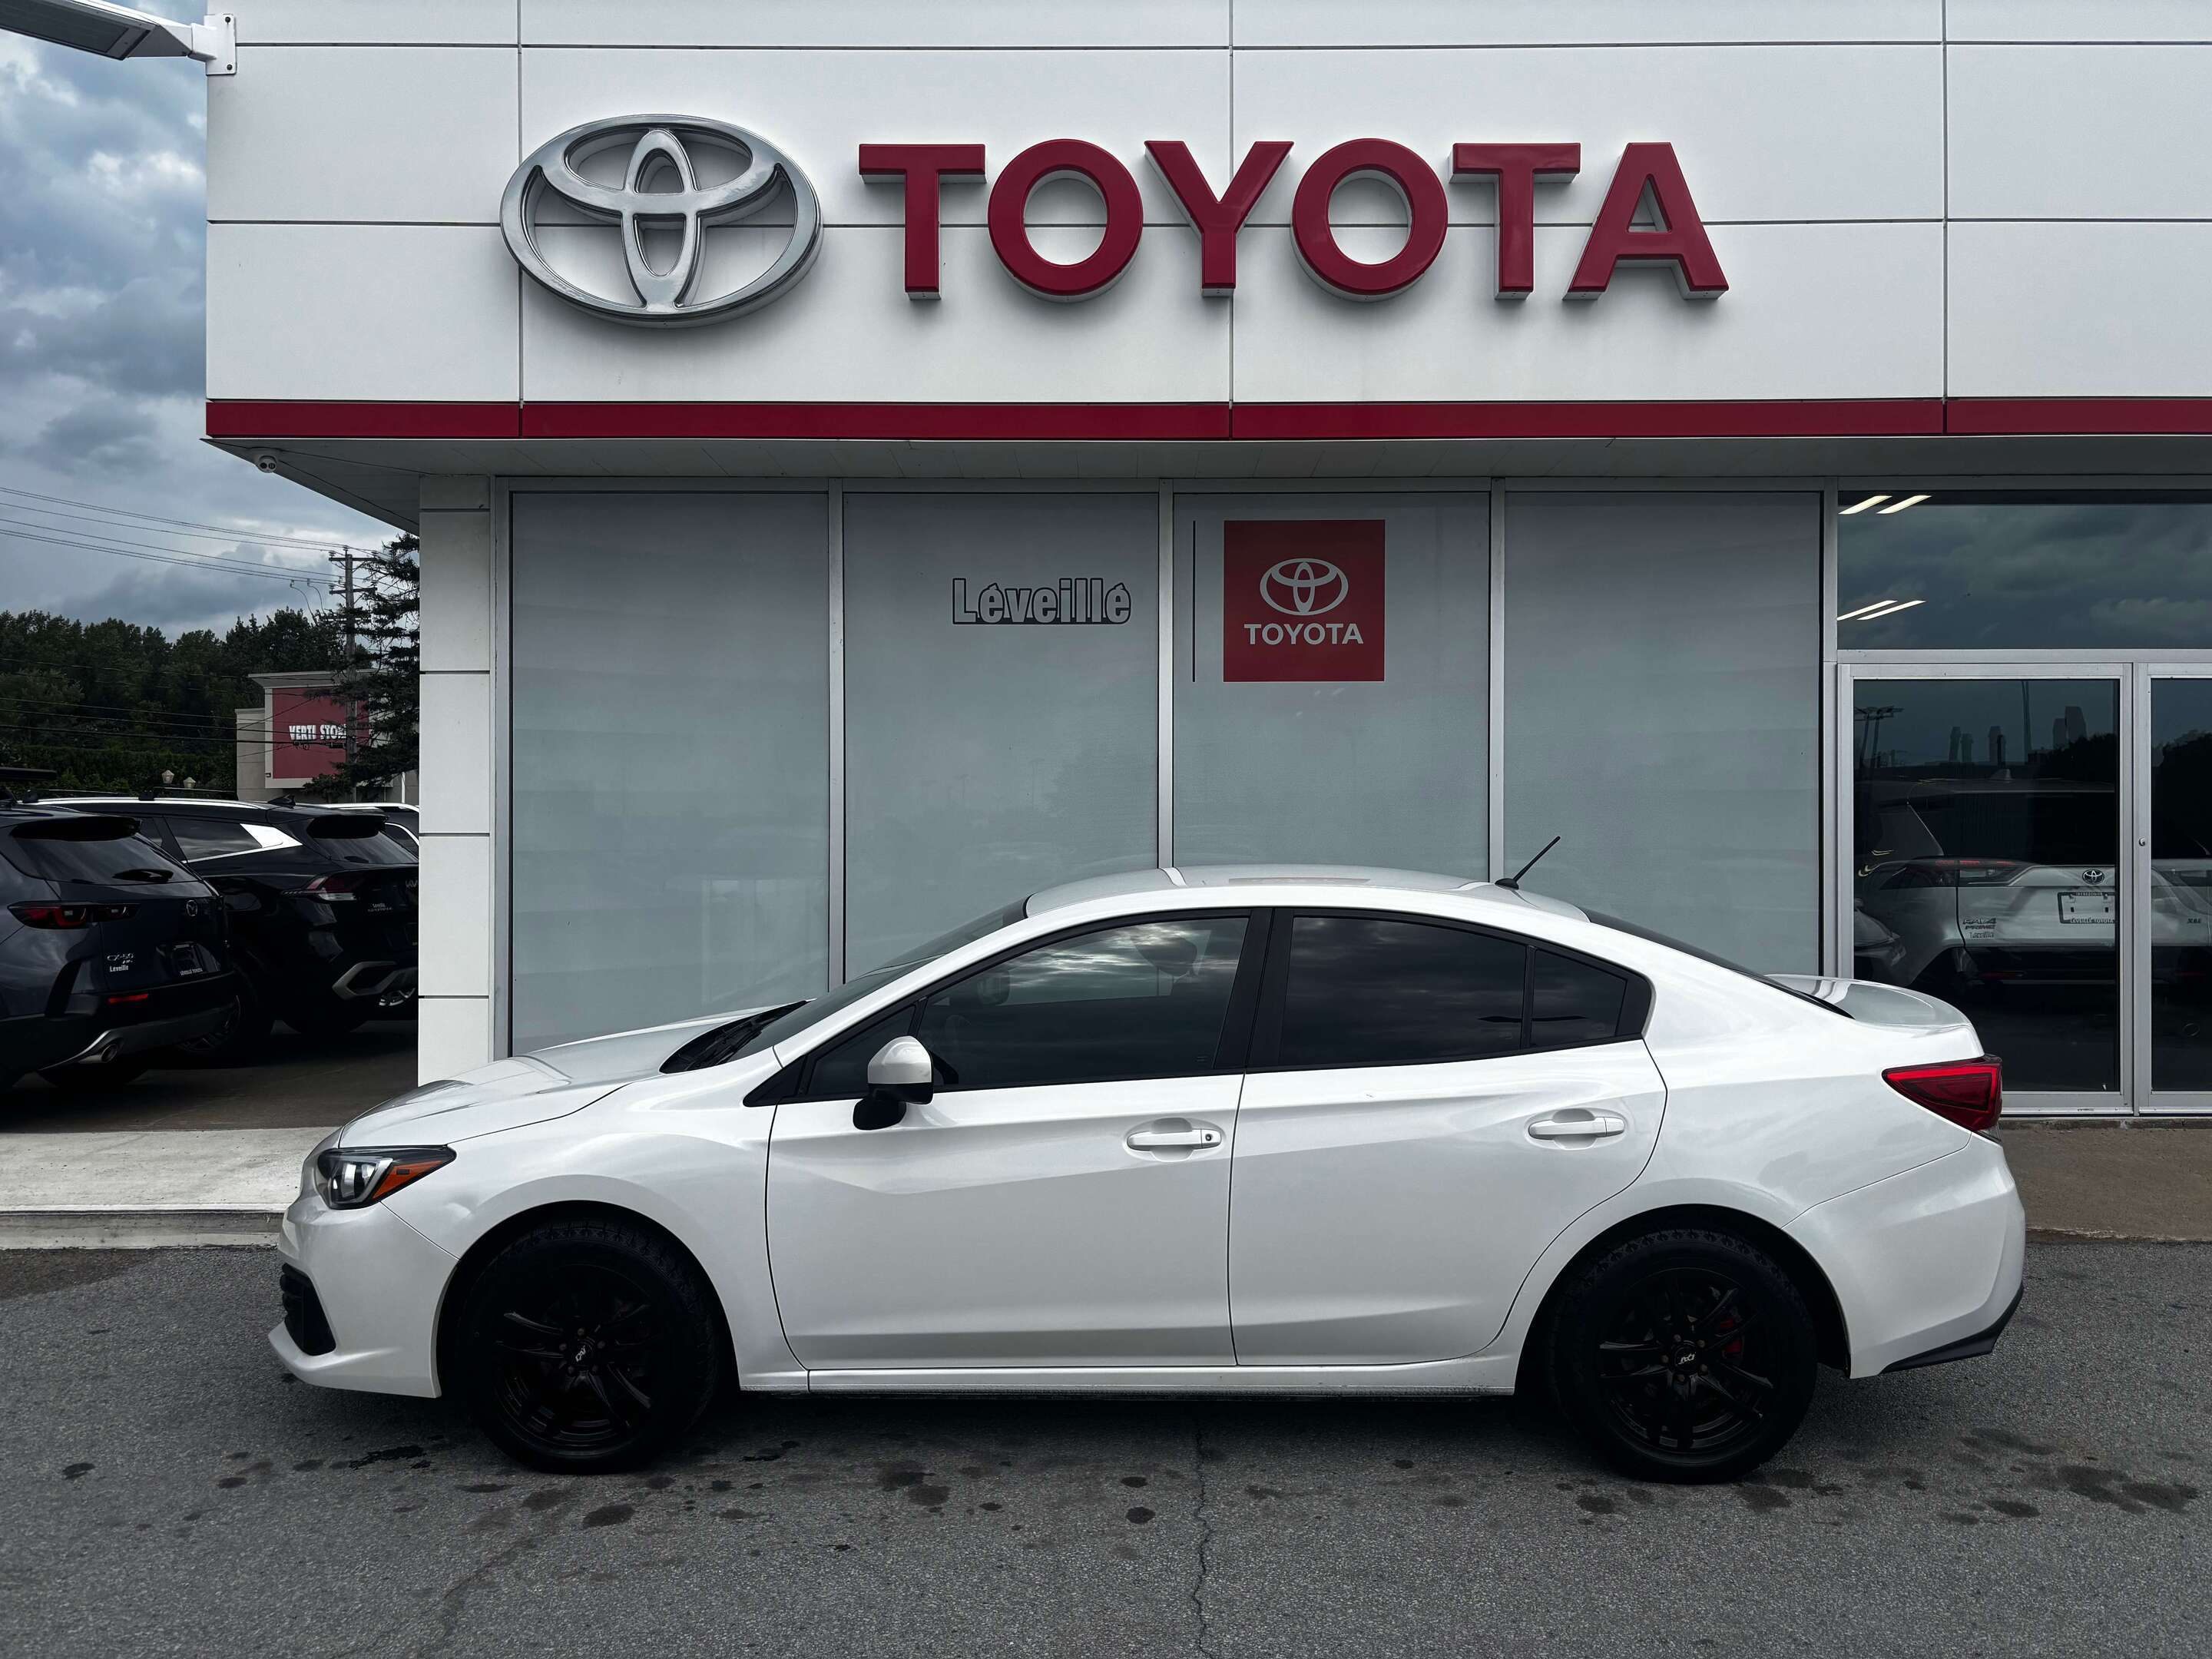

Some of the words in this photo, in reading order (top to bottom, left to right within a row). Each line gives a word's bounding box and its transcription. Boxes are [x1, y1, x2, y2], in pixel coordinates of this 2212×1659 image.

[859, 137, 1729, 302] TOYOTA
[952, 578, 1131, 625] Léveillé
[1243, 623, 1364, 645] TOYOTA
[289, 725, 316, 740] VERTI
